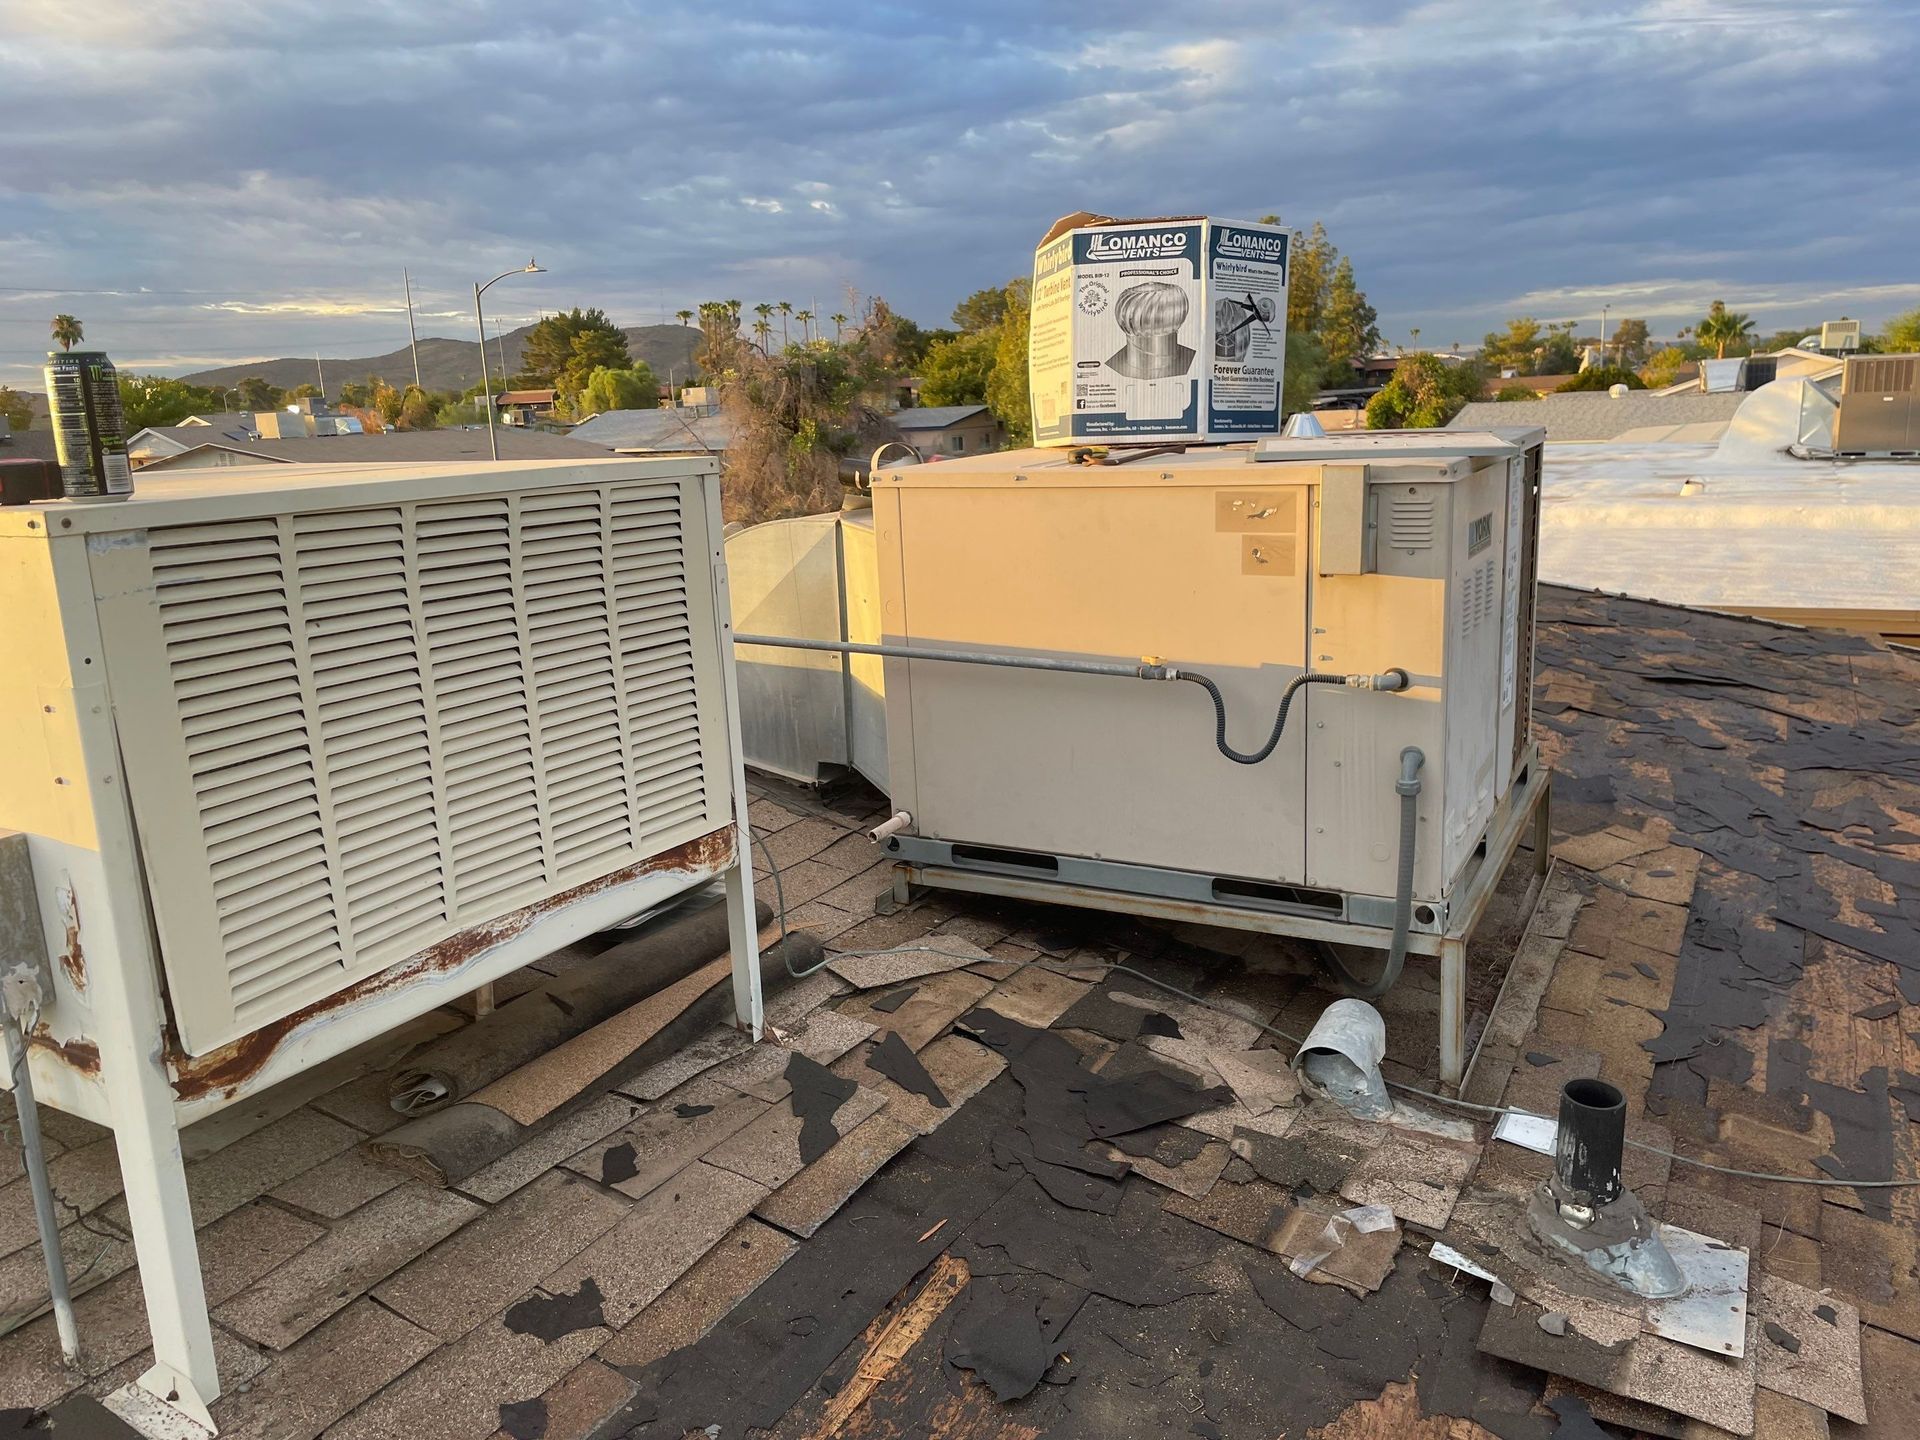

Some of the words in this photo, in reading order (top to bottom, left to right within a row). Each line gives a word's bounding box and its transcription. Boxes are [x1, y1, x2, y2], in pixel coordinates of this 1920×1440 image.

[1091, 233, 1187, 250] LOMANCO
[1220, 228, 1281, 252] LOMANCO
[1122, 248, 1160, 259] VENTS
[1241, 248, 1265, 260] VENTS
[1160, 268, 1177, 276] CHOICE
[1215, 261, 1248, 274] Whirlybird
[1079, 284, 1089, 294] The
[1088, 280, 1110, 294] Original
[1213, 364, 1241, 375] Forever
[1241, 365, 1275, 376] Guarantee
[1474, 513, 1493, 542] YORK
